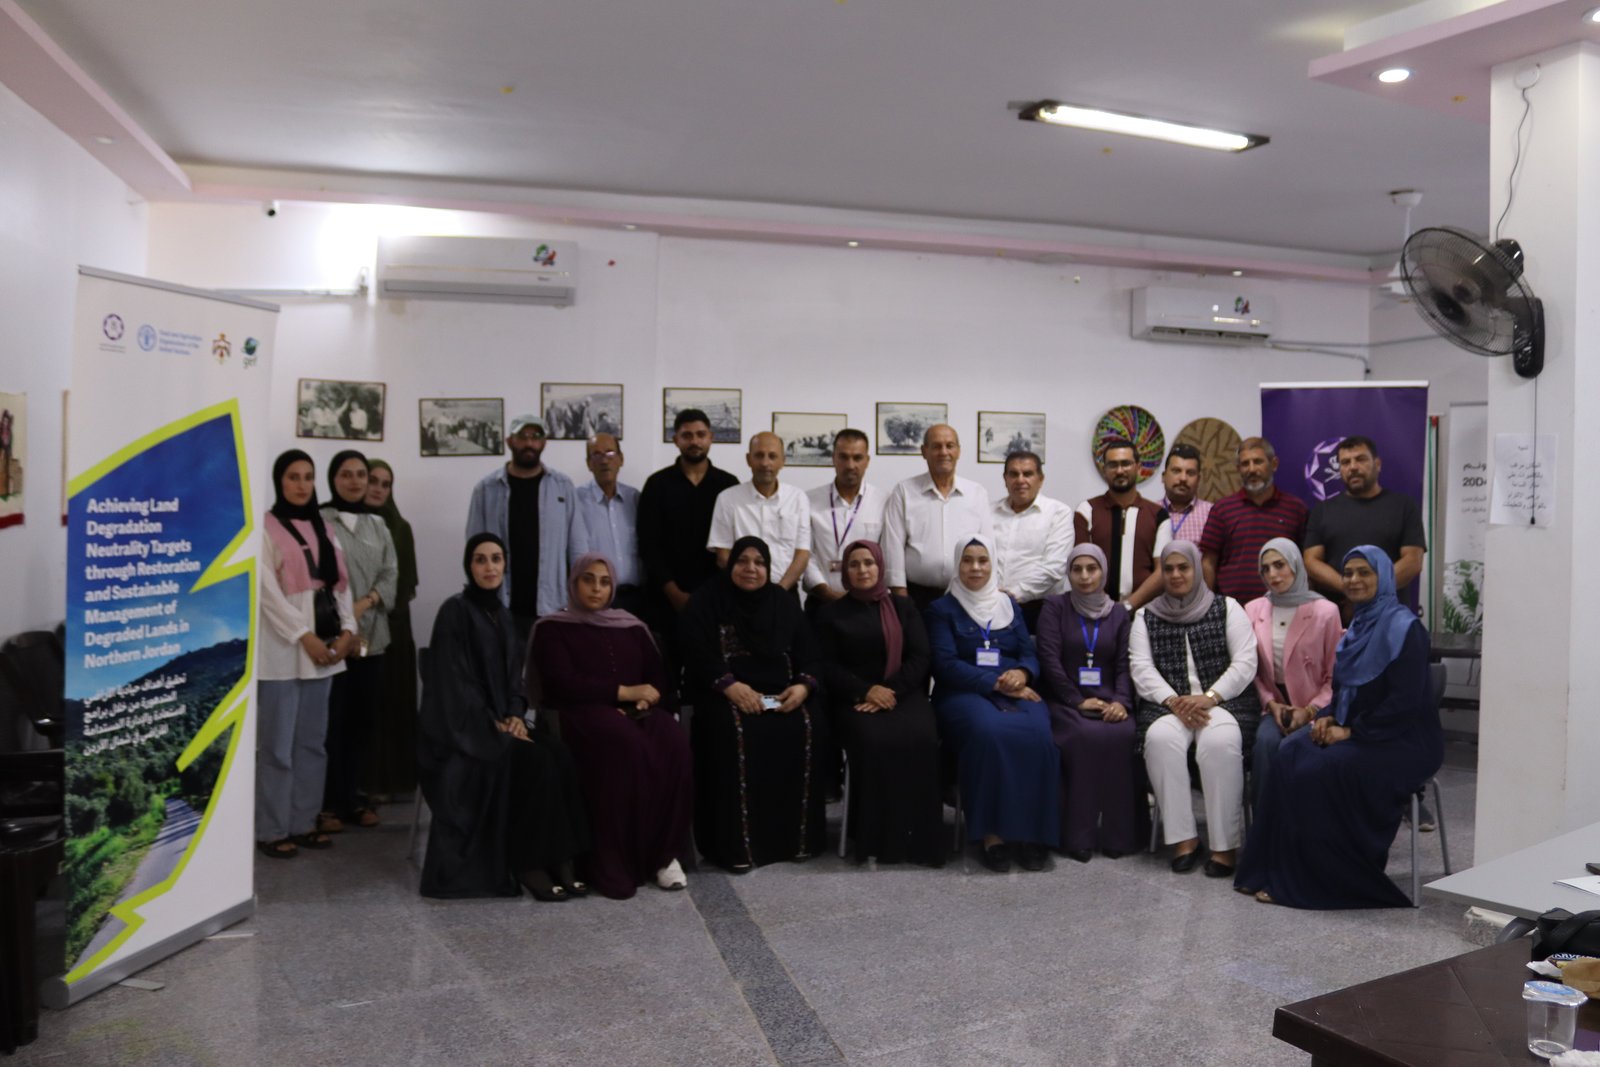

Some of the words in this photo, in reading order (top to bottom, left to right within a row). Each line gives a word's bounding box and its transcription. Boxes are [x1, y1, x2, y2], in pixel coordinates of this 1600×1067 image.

[86, 498, 149, 516] Achieving
[150, 498, 179, 512] Land
[86, 518, 162, 539] Degradation
[86, 540, 150, 558] Neutrality
[150, 539, 192, 557] Targets
[85, 562, 136, 581] through
[137, 558, 201, 577] Restoration
[84, 586, 111, 603] and
[112, 580, 179, 600] Sustainable
[84, 604, 164, 624] Management
[164, 600, 178, 615] of
[84, 626, 145, 648] Degraded
[145, 622, 178, 638] Lands
[179, 619, 190, 632] in
[84, 650, 142, 668] Northern
[142, 642, 181, 660] Jordan
[109, 701, 127, 717] خلال
[127, 701, 140, 713] من
[83, 718, 125, 736] المستدامة
[83, 738, 109, 756] الأردن
[109, 731, 132, 750] شمال
